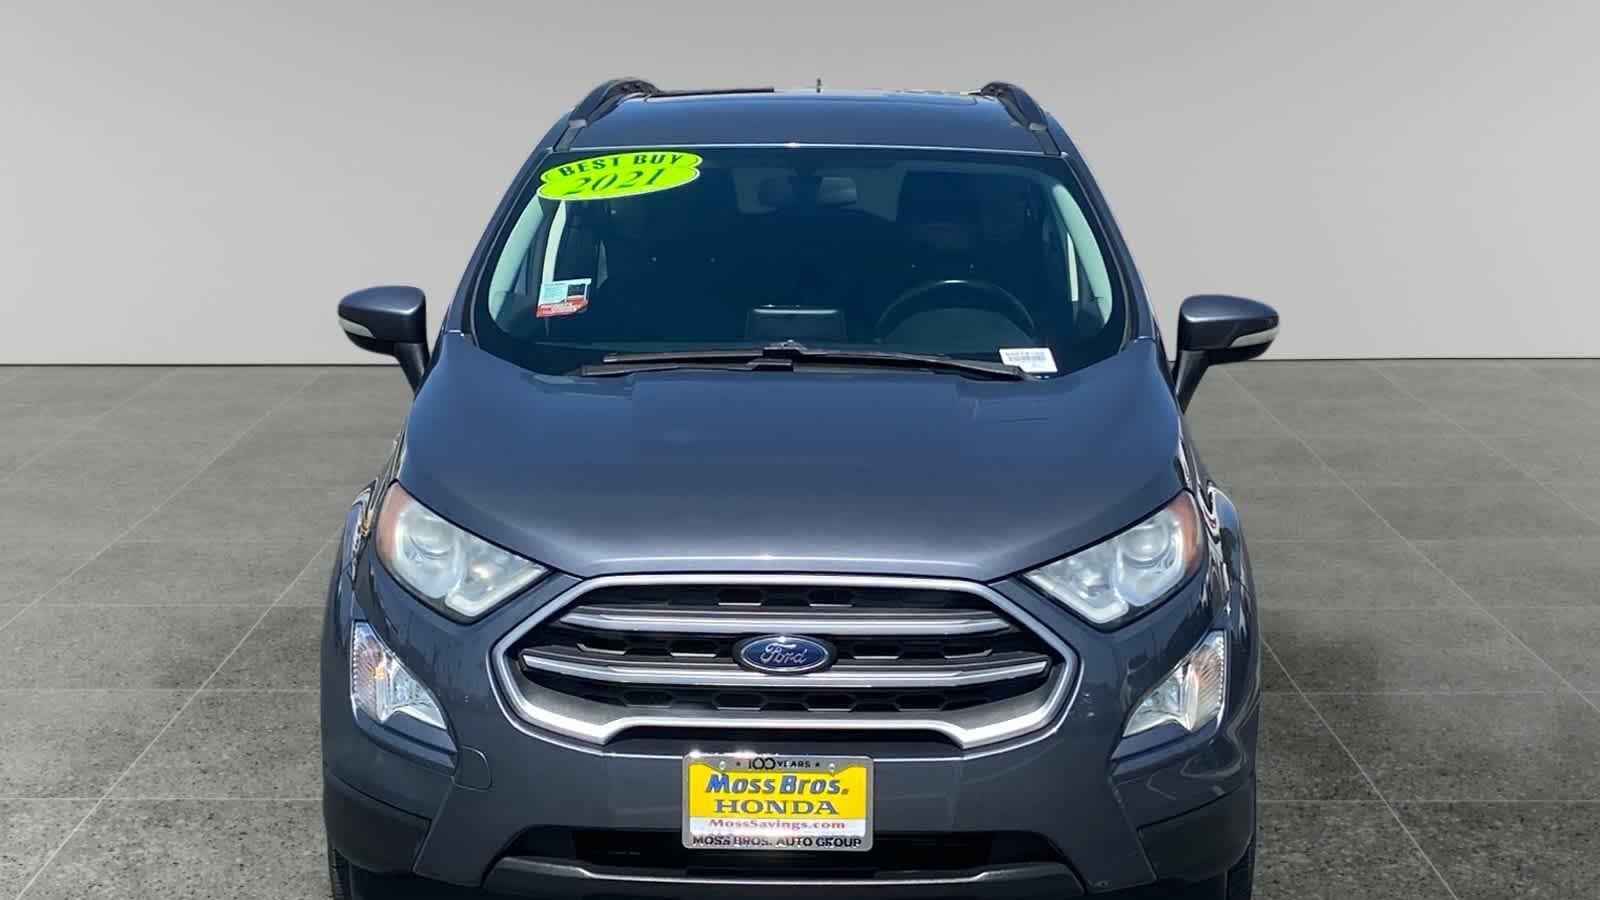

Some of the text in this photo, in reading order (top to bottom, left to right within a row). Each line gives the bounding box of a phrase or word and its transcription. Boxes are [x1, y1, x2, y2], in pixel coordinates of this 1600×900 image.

[557, 154, 684, 177] BEST BUY
[562, 167, 666, 196] 2021
[760, 642, 808, 664] Ford
[776, 760, 811, 769] YEARS
[705, 773, 849, 796] Moss Bros.
[713, 798, 840, 815] HONDA
[709, 819, 846, 831] MossSavings.com
[692, 835, 730, 846] MOSS
[777, 836, 813, 847] AUTO
[815, 836, 862, 848] GROUP
